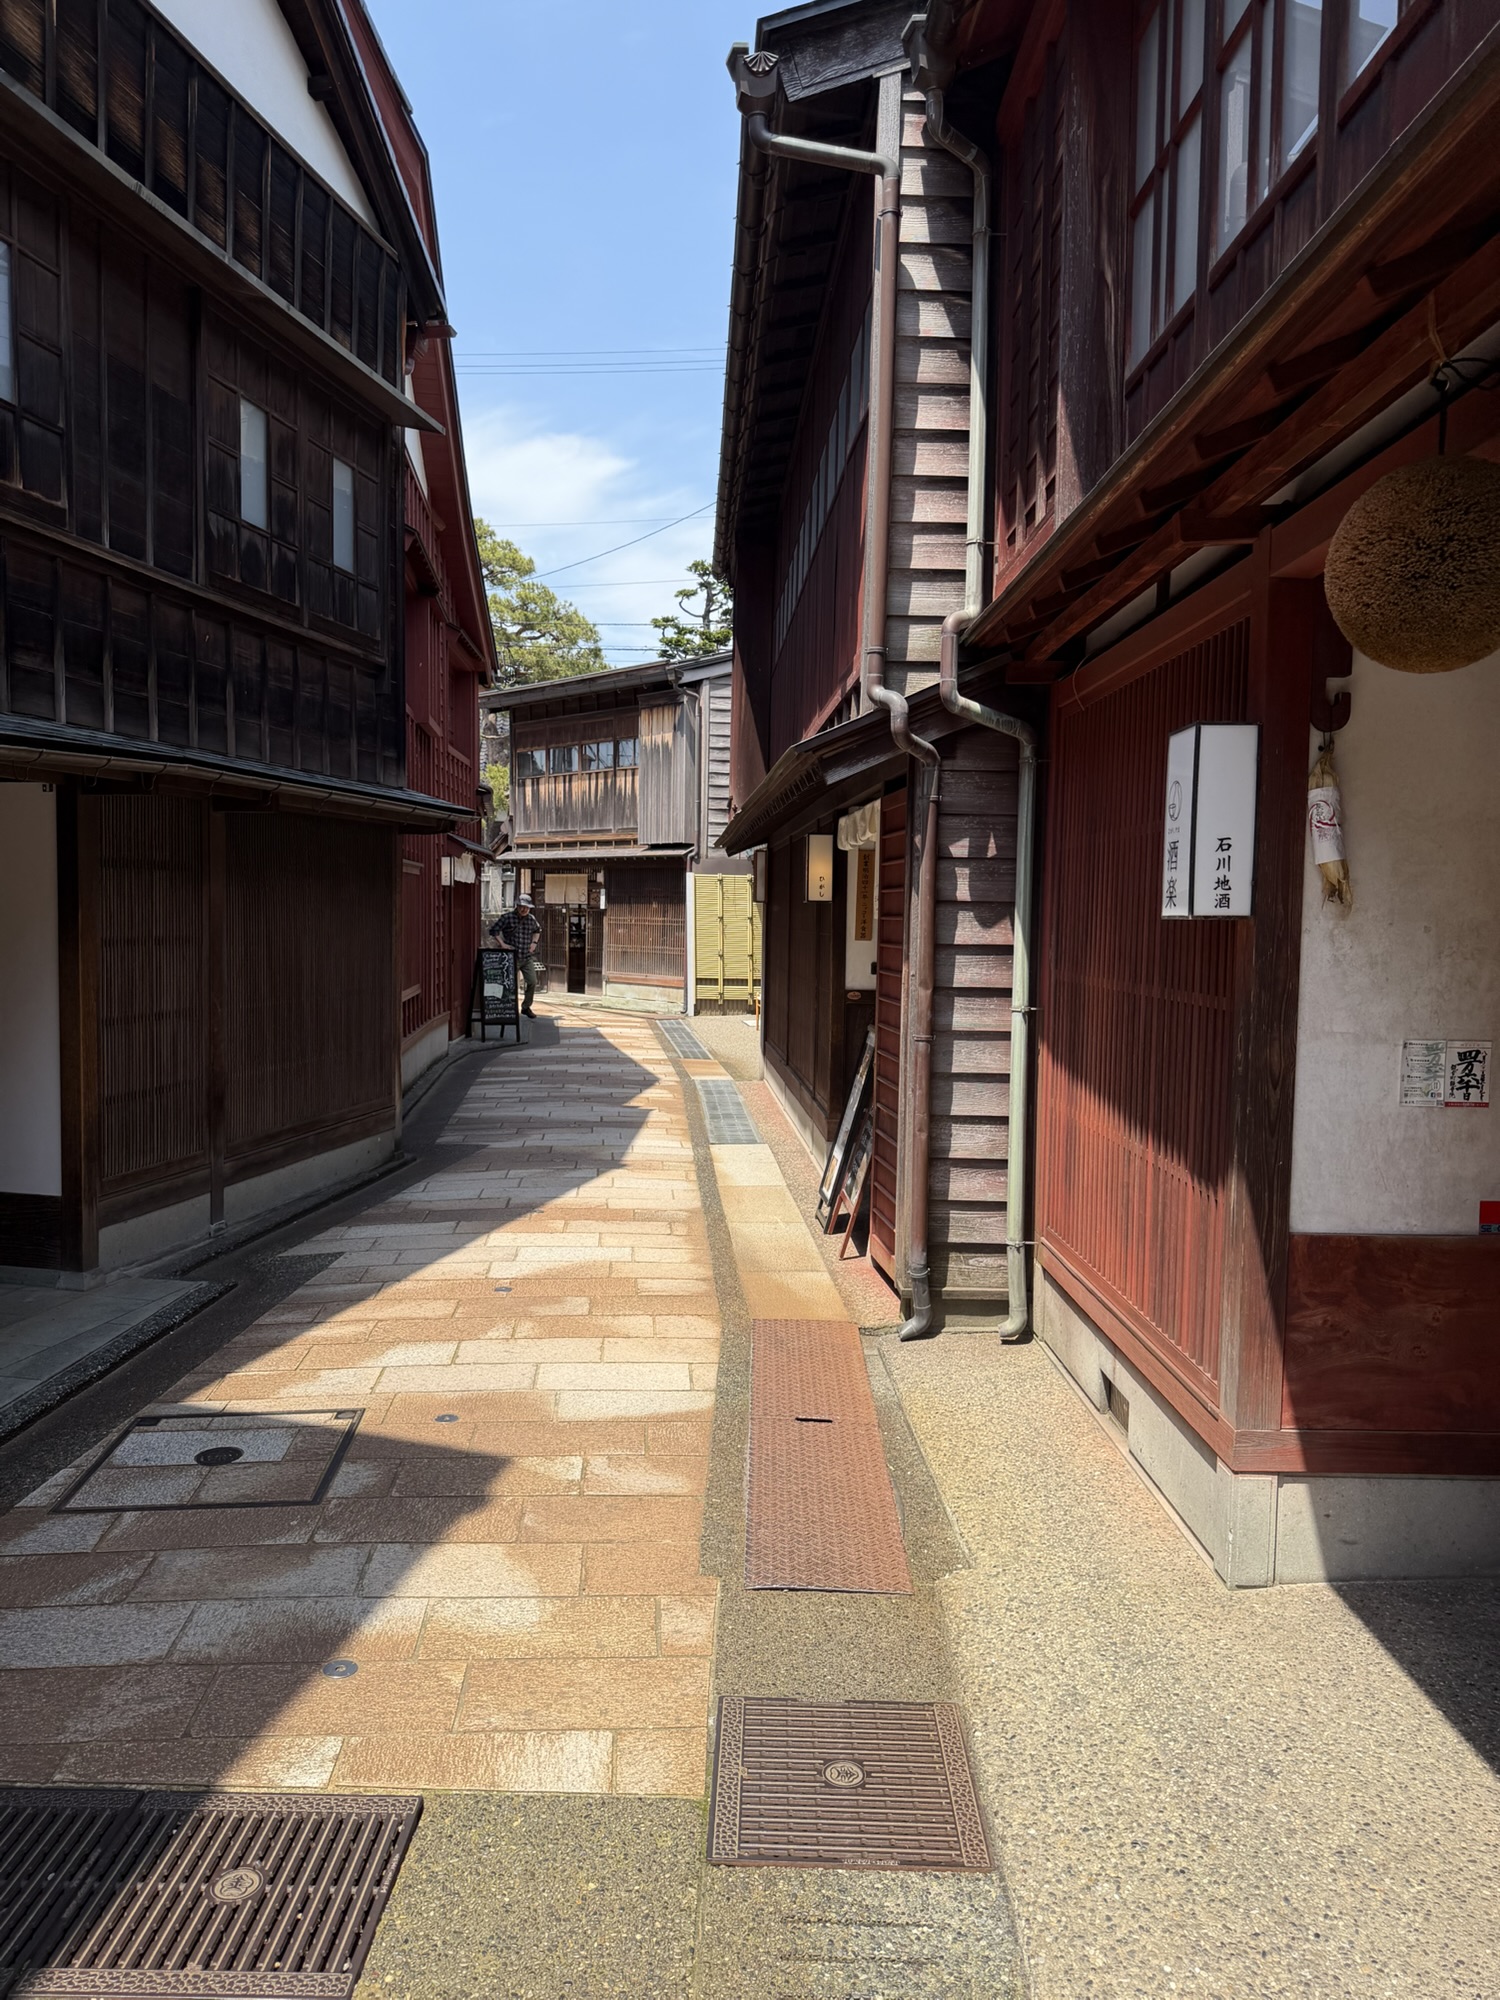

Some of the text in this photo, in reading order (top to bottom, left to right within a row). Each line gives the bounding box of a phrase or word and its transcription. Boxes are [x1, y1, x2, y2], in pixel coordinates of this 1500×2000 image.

[1213, 836, 1232, 909] 石川地酒
[1455, 1049, 1483, 1101] 四万六千日
